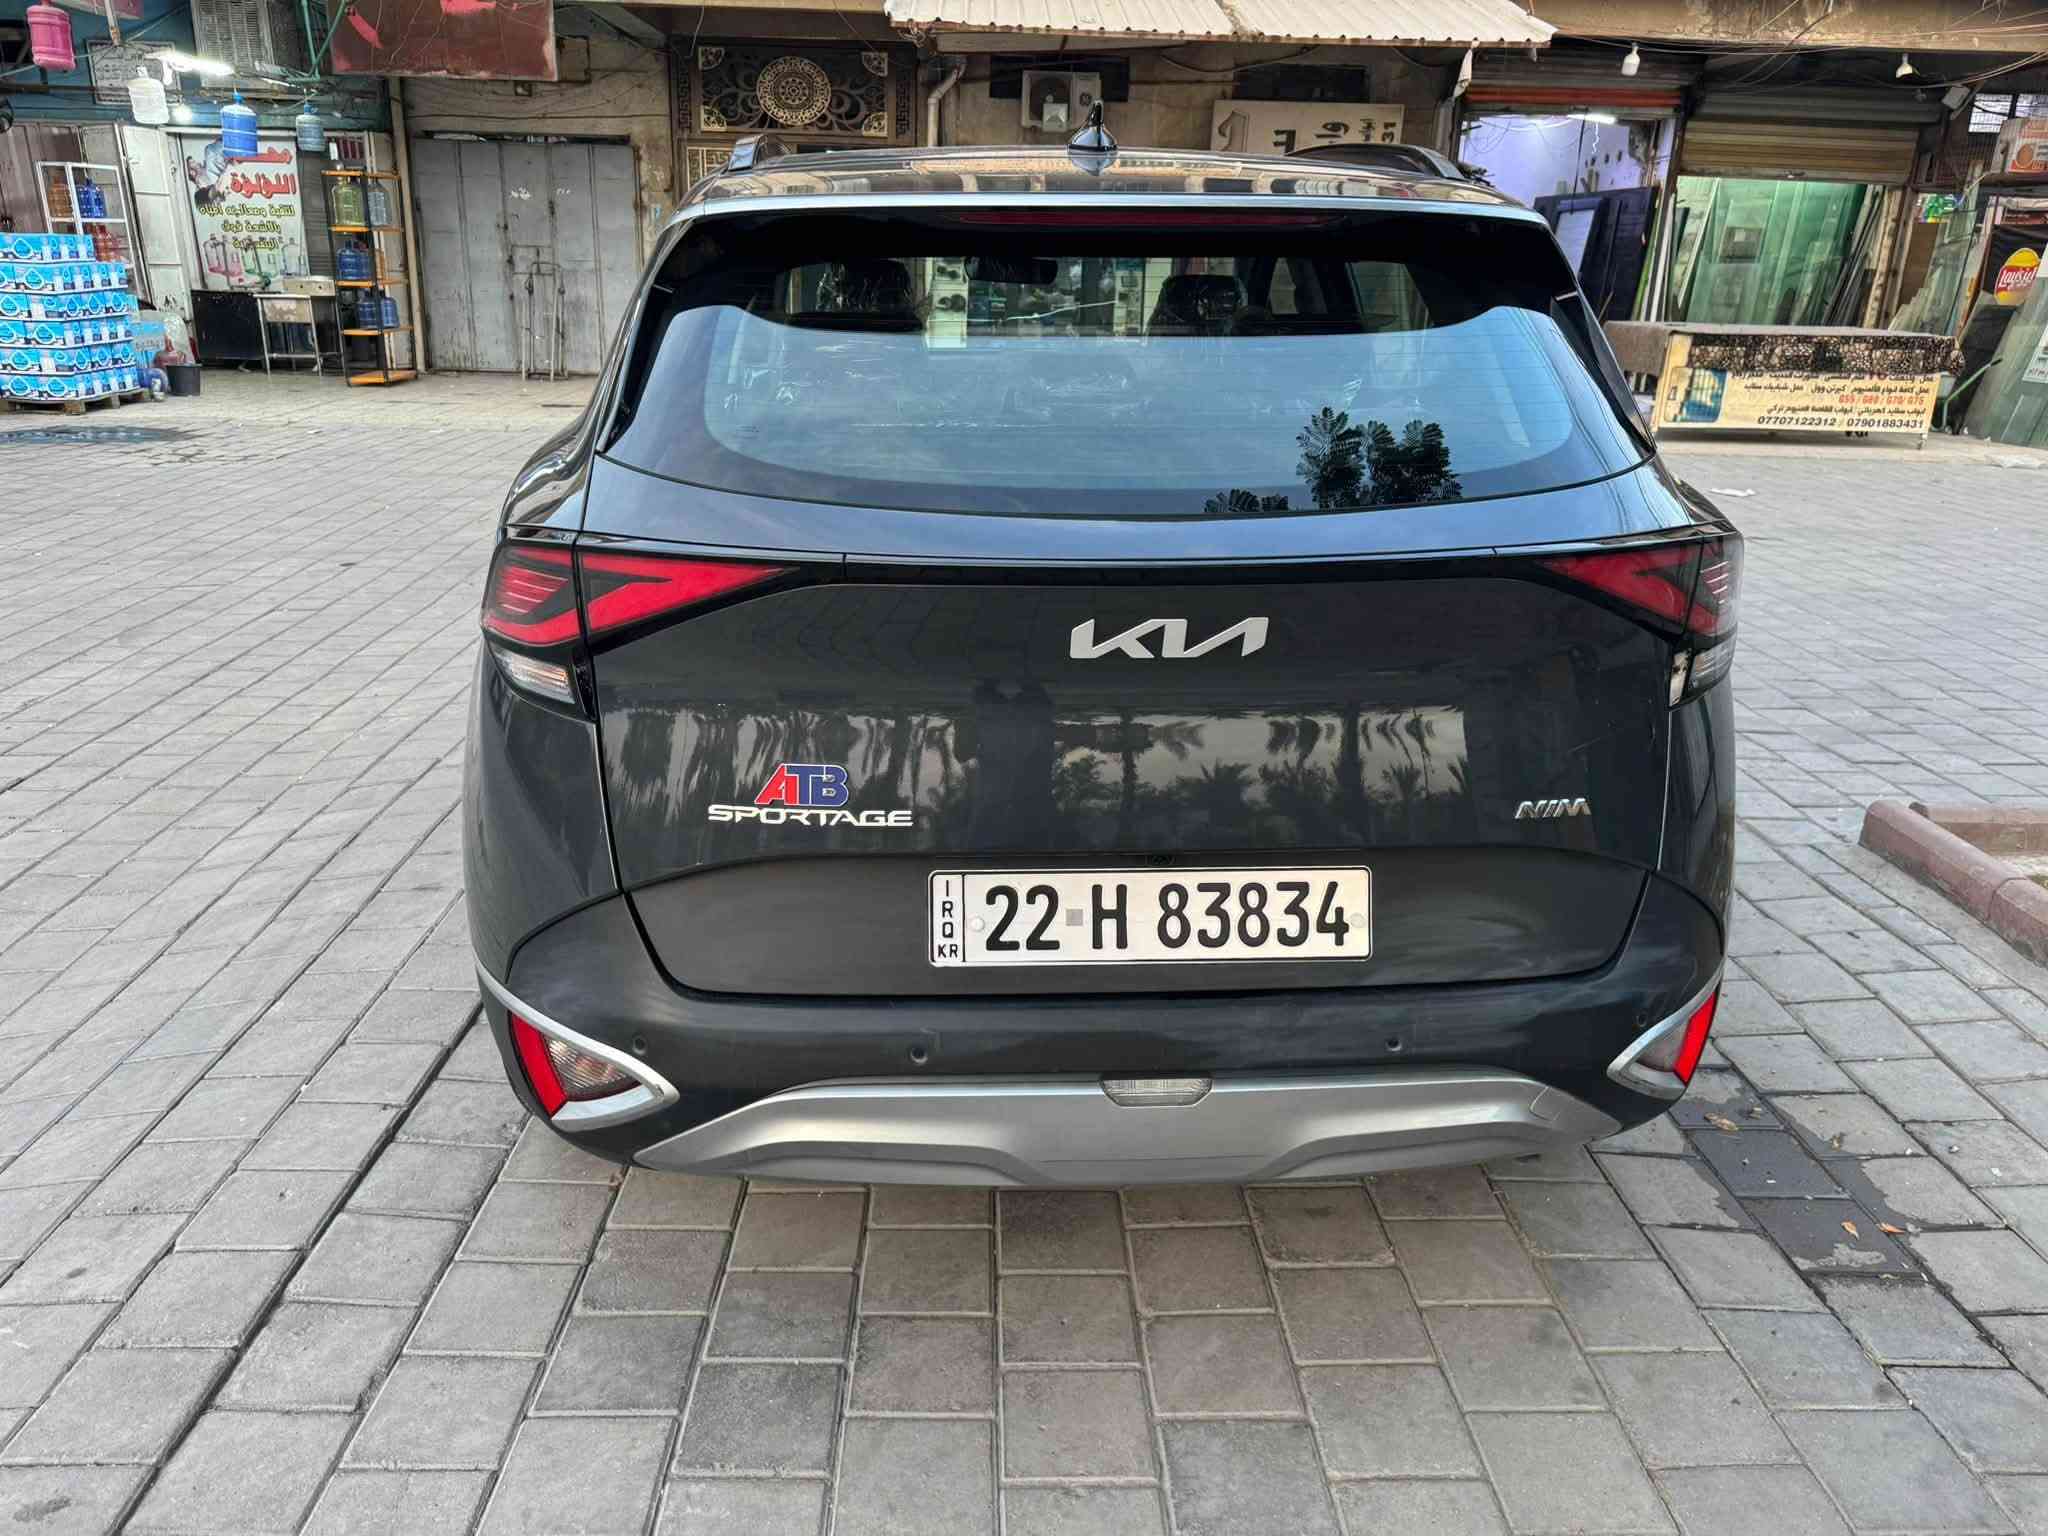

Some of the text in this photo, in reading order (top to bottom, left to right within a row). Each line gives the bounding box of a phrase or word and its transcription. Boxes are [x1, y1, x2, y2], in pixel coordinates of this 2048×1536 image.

[1757, 415, 1924, 429] 07707122312 07901883431
[1069, 616, 1269, 659] KIA
[754, 763, 849, 807] ATB
[708, 804, 914, 827] SPORTAGE
[985, 881, 1349, 951] 22 H 83834
[937, 944, 959, 959] KR
